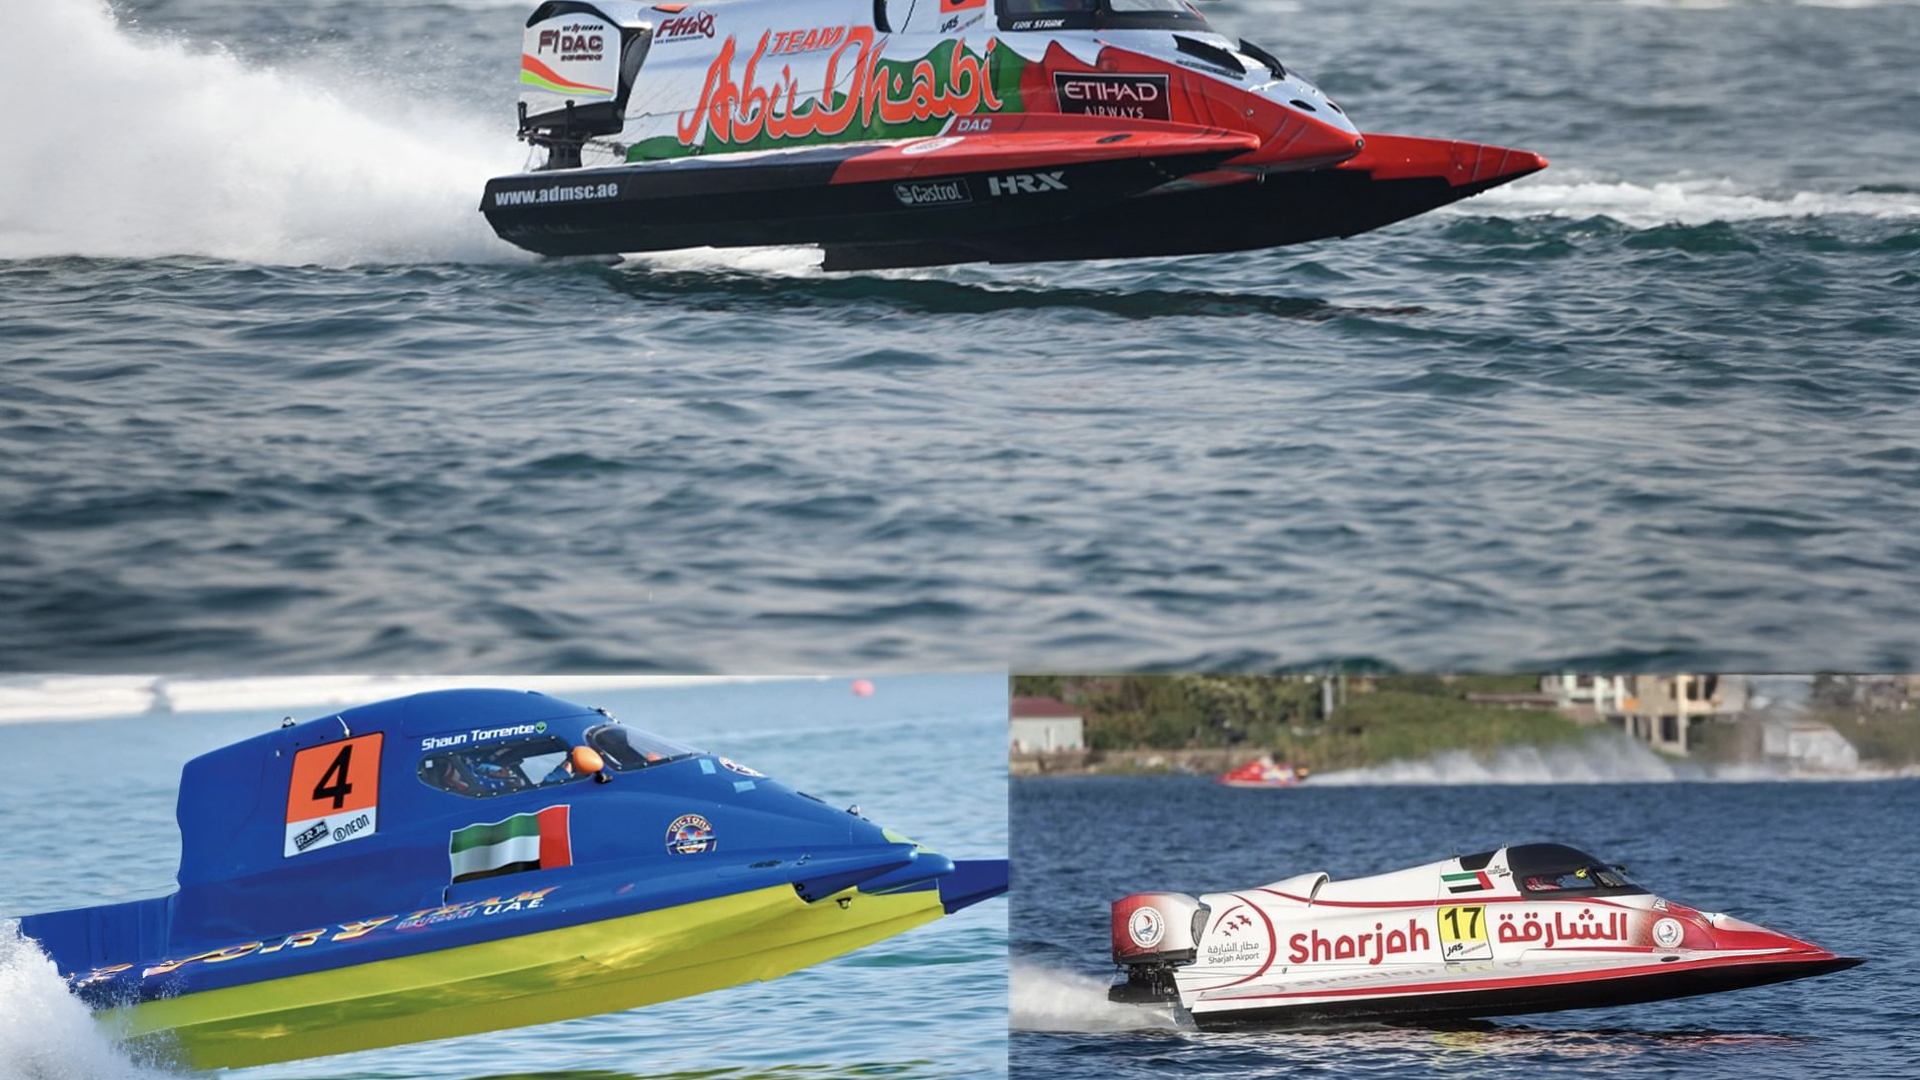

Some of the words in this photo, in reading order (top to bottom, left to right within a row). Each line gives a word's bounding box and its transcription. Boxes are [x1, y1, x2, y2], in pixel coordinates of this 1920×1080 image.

[562, 35, 604, 52] DAC
[770, 26, 844, 54] TEAM
[677, 29, 806, 145] Abu
[812, 26, 1002, 136] Dhabi
[1064, 80, 1158, 101] ETIHAD
[1084, 105, 1144, 119] AIRWAYS
[957, 118, 992, 132] DAC
[495, 182, 618, 206] www.admsc.ae
[911, 182, 961, 203] Castrol
[988, 171, 1069, 196] HRX
[421, 734, 467, 751] Shaun
[471, 724, 535, 741] Torrente
[312, 744, 353, 810] 4
[671, 815, 712, 832] VICTORY
[483, 897, 544, 916] U.A.E.
[1444, 906, 1482, 940] 17
[1498, 908, 1627, 948] الشارقة
[1207, 942, 1238, 956] الشارقة
[1288, 918, 1430, 965] Sharjah
[1447, 943, 1464, 957] JAS
[1208, 955, 1235, 964] Sharjah
[1235, 953, 1260, 962] Airport
